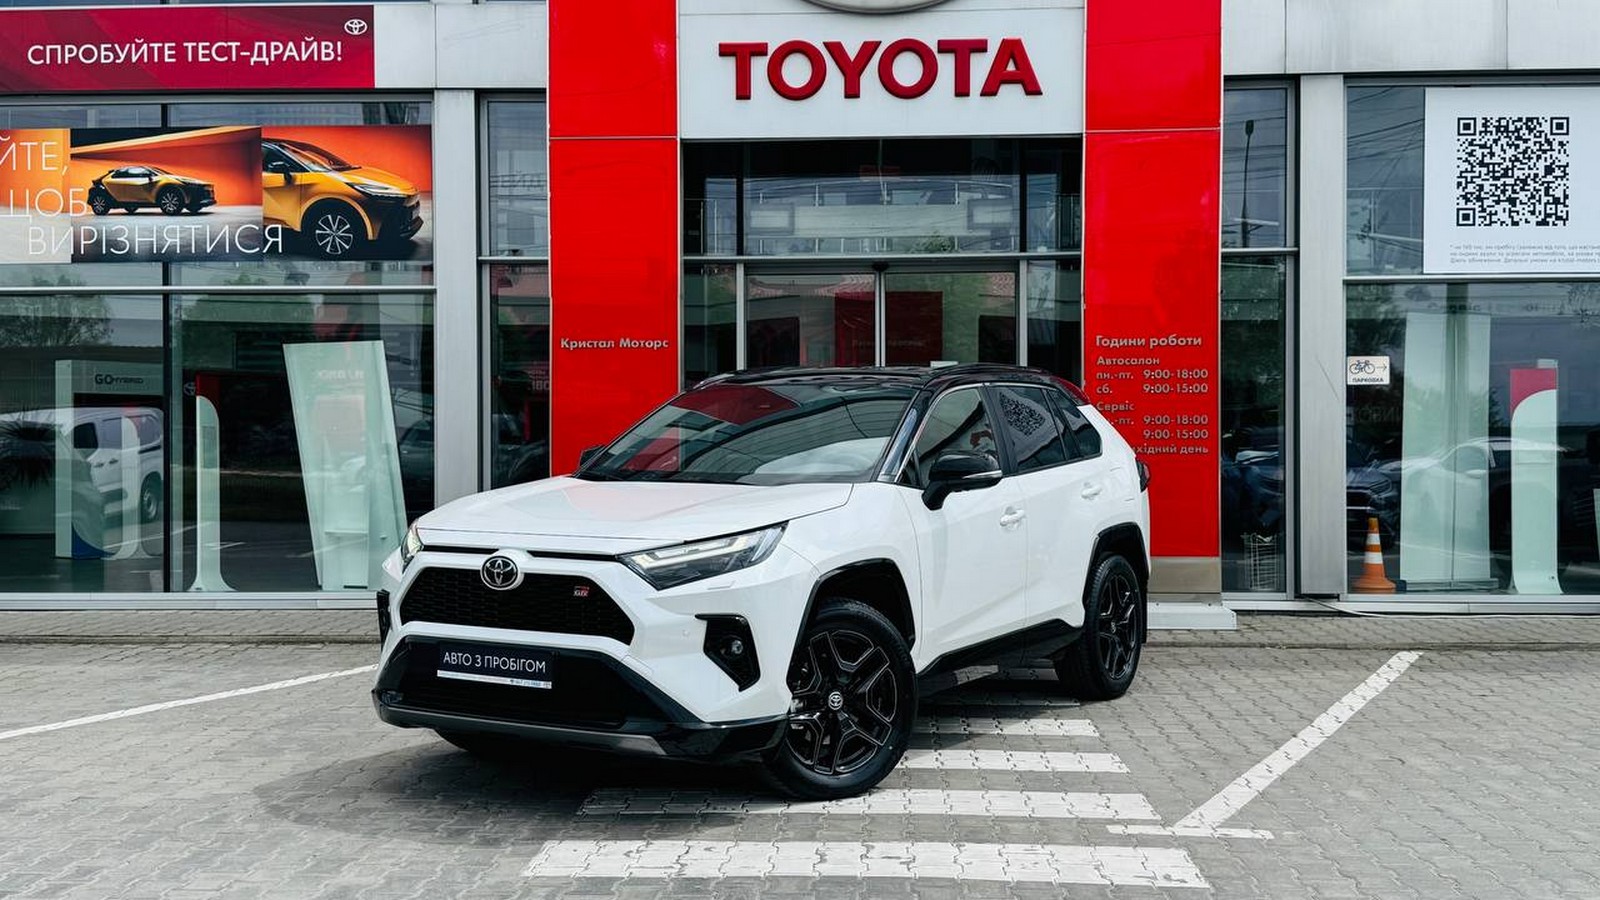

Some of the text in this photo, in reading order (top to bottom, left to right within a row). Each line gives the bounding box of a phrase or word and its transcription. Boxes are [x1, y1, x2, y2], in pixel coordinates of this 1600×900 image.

[27, 36, 343, 67] СПРОБУЙТЕ ТЕСТ-ДРАЙВ!
[718, 38, 1043, 101] TOYOTA
[28, 224, 283, 256] ВИРІЗНЯТИСЯ
[560, 338, 669, 350] Кристал Моторс
[1096, 334, 1202, 349] Години роботи
[1096, 355, 1160, 366] Автосалон
[1096, 383, 1113, 394] сб.
[1096, 400, 1135, 413] Сервіс
[1134, 442, 1209, 454] хідний день
[443, 651, 472, 667] АВТО
[484, 655, 546, 674] ПРОБІГОМ
